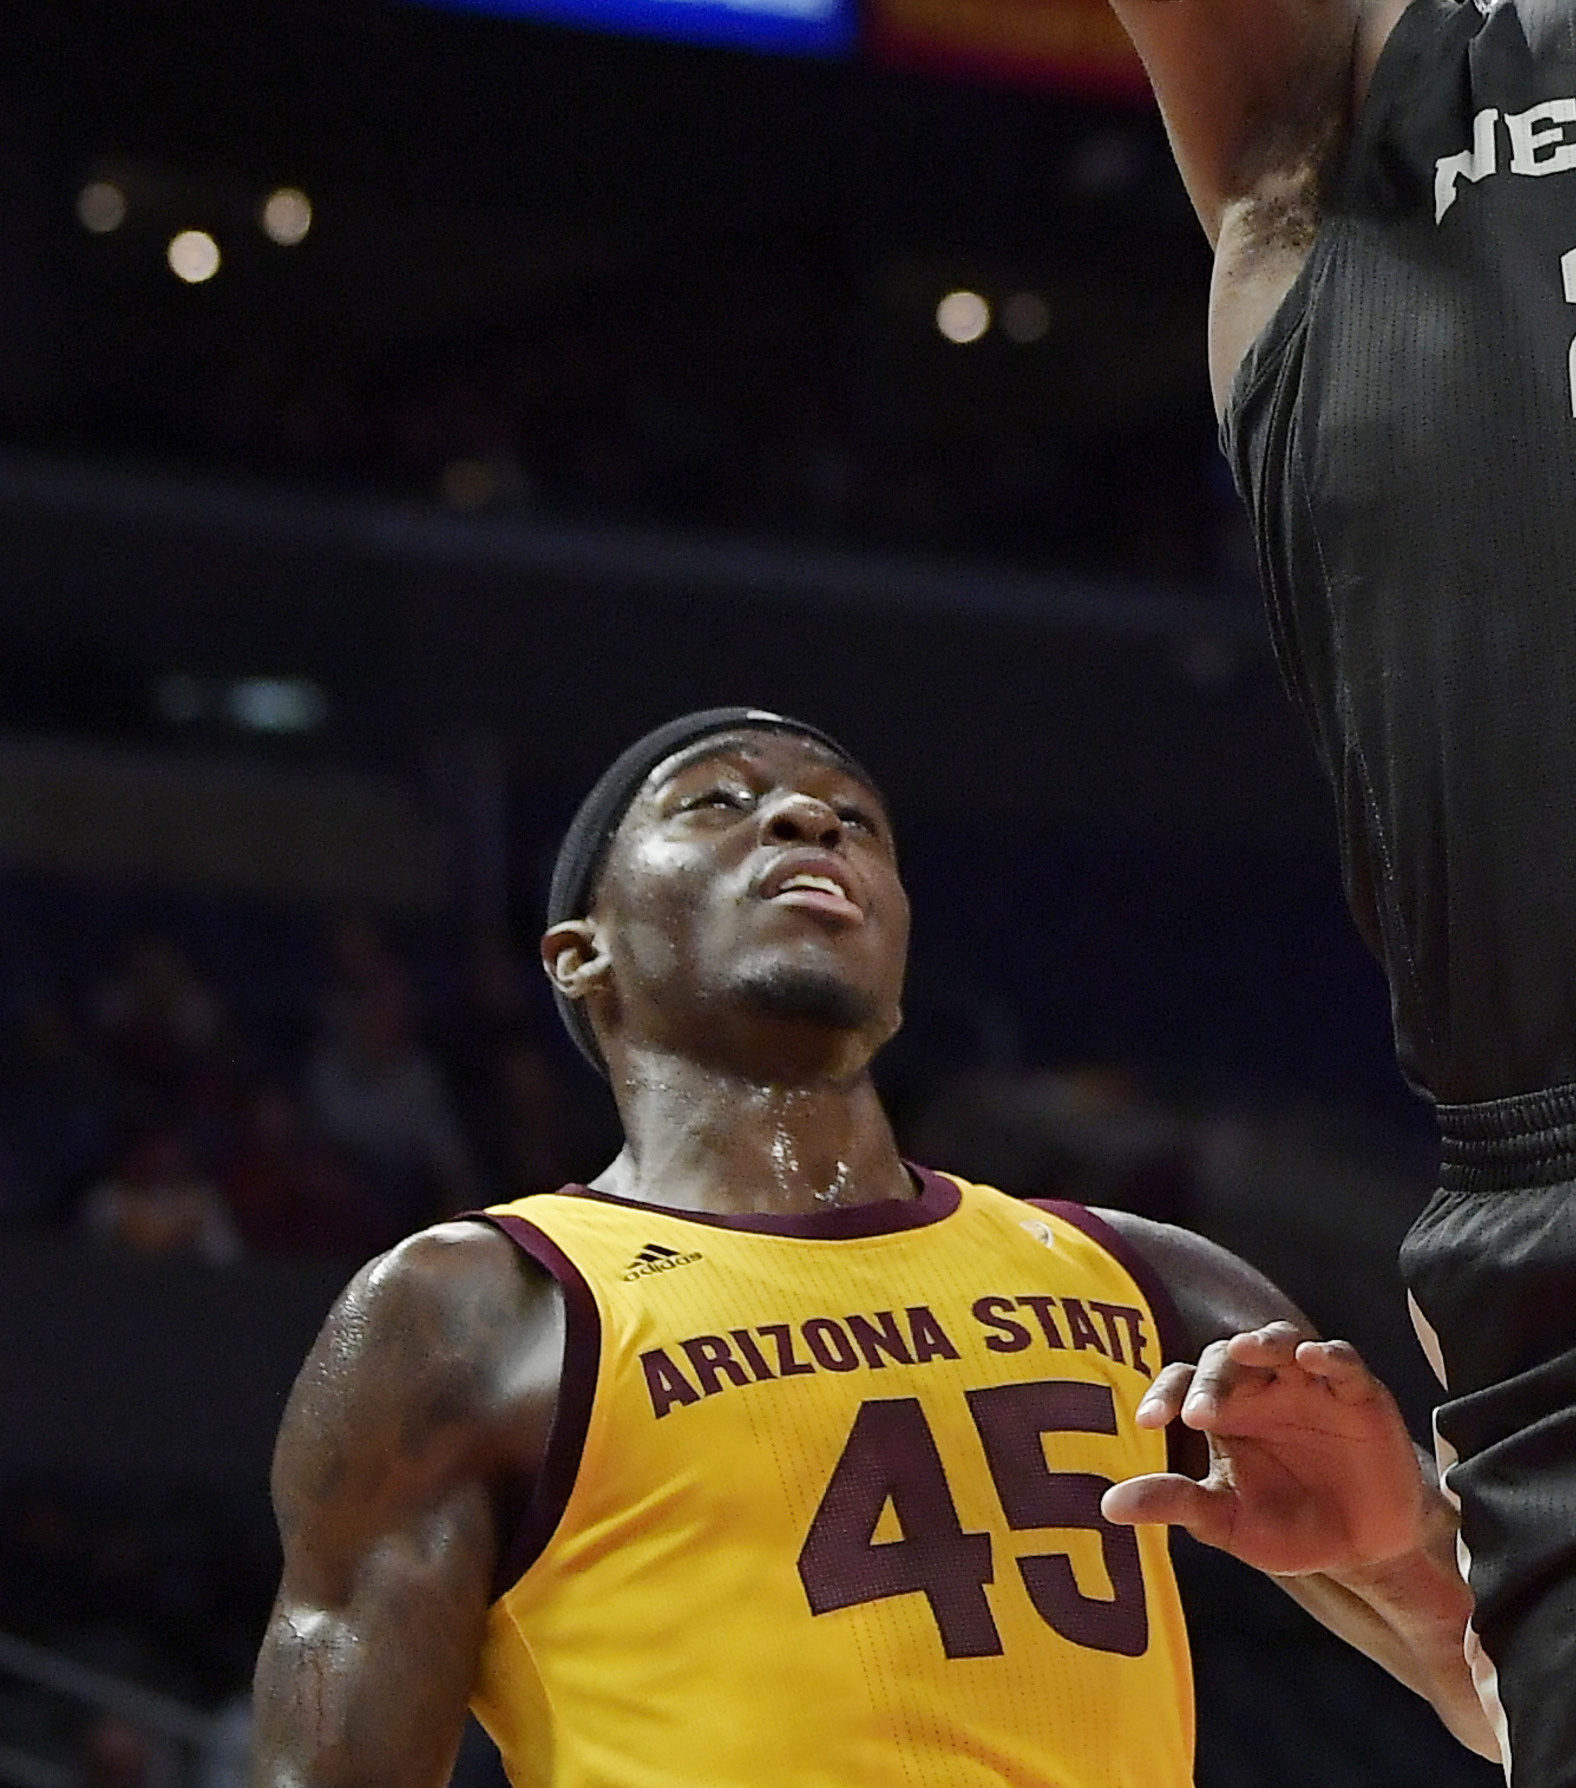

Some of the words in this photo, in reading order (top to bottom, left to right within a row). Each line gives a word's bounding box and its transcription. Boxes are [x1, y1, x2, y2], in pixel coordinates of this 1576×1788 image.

[623, 1252, 703, 1282] adidas
[638, 1306, 961, 1419] ARIZONA
[971, 1296, 1153, 1379] STATE
[797, 1380, 1149, 1660] 45
